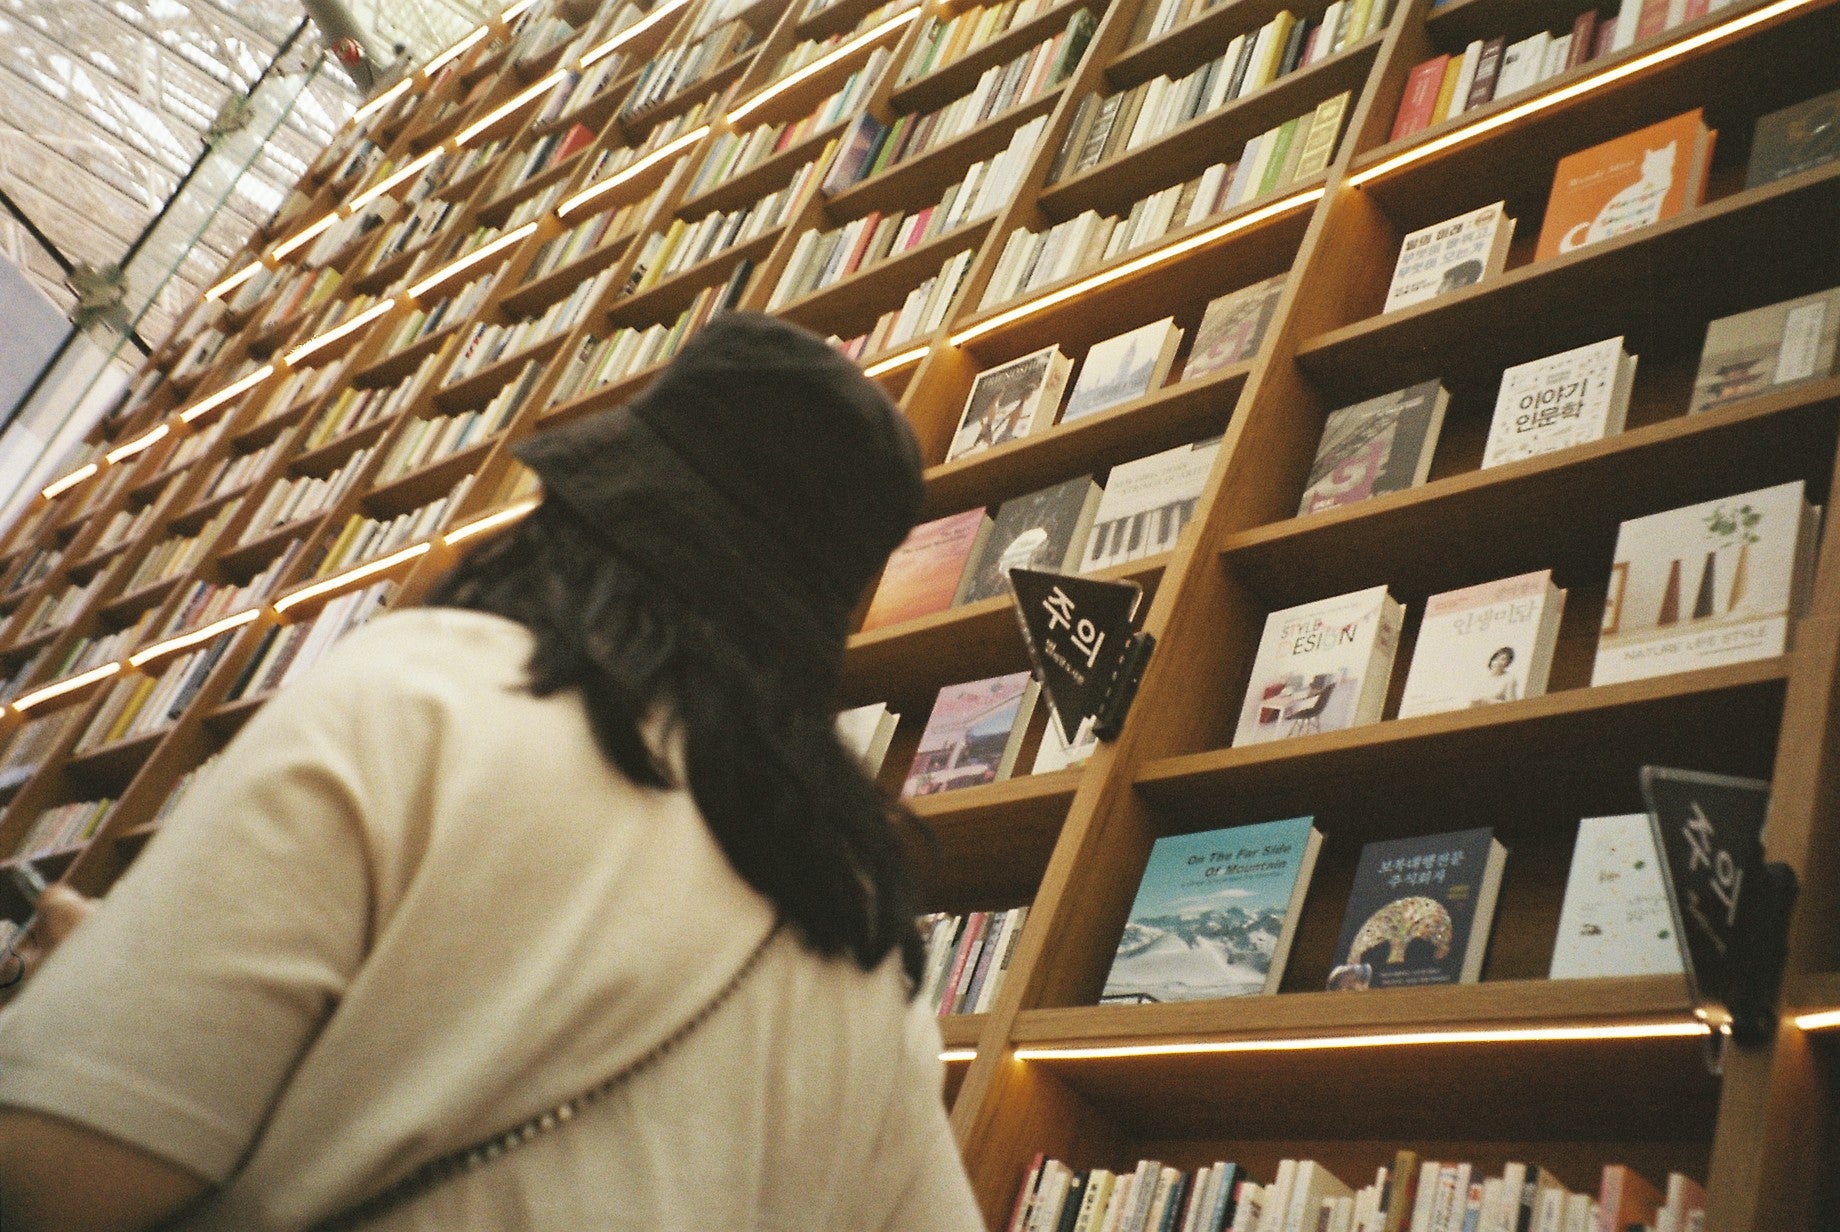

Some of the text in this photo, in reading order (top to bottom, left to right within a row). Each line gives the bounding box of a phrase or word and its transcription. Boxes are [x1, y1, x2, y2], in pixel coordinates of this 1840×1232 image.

[1520, 378, 1588, 410] 이야기
[1515, 401, 1584, 433] 인문학
[1042, 586, 1106, 668] 주의
[1187, 844, 1292, 866] On The Far Side
[1226, 860, 1288, 875] Mountain
[1682, 801, 1743, 927] 주의
